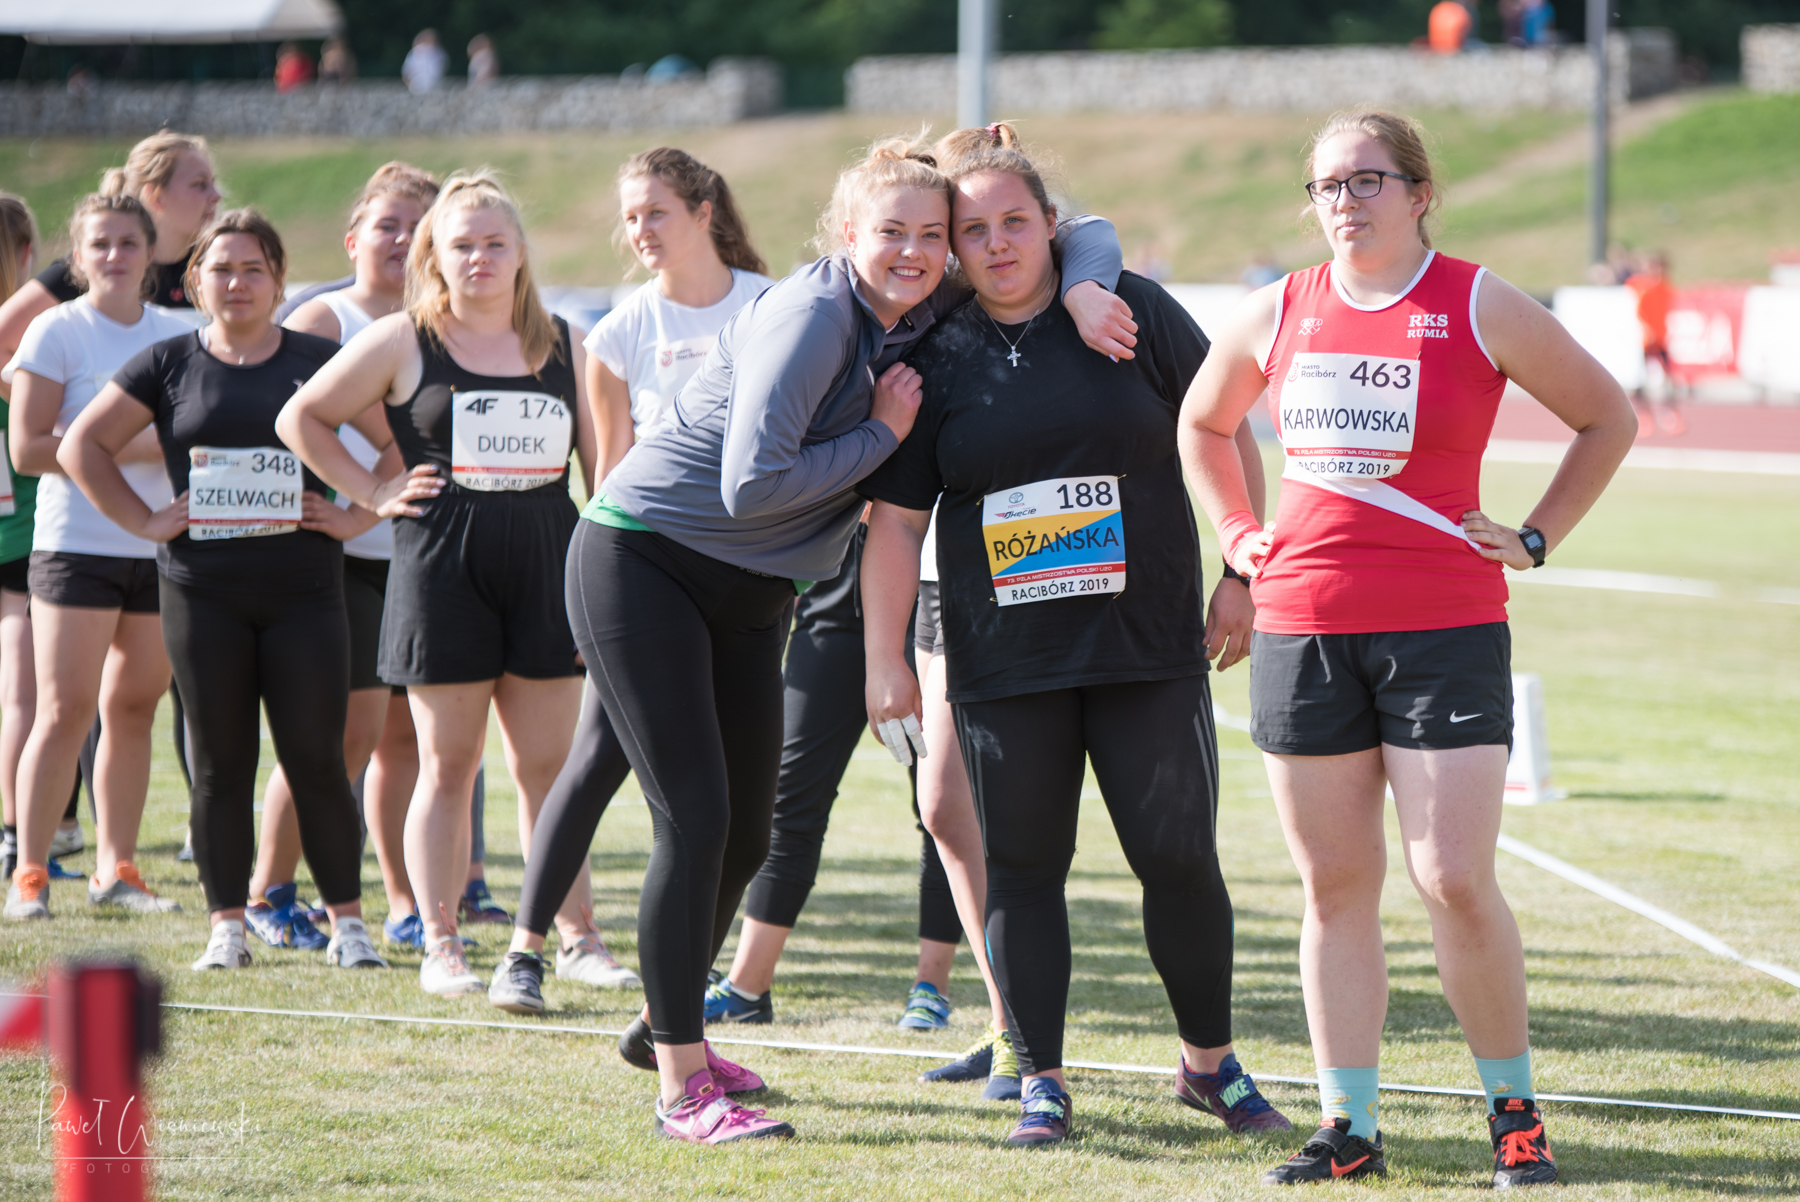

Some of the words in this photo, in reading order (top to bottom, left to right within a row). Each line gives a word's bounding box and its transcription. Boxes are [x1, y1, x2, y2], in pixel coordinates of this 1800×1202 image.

[1408, 313, 1448, 327] RKS
[1406, 329, 1449, 339] RUMIA
[1301, 369, 1337, 378] Racibórz
[1349, 360, 1411, 389] 463
[464, 397, 499, 415] 4F
[519, 397, 564, 420] 174
[1283, 408, 1410, 434] KARWOWSKA
[477, 435, 546, 455] DUDEK
[251, 452, 296, 476] 348
[1357, 462, 1390, 475] 2019
[466, 474, 523, 489] RACIBÓRZ
[195, 487, 295, 508] SZELWACH
[1056, 481, 1113, 509] 188
[993, 526, 1120, 561] RÓŻAŃSKA
[1032, 569, 1076, 580] MISTRZOSTWA
[1076, 566, 1098, 574] POLSKI
[1011, 580, 1075, 601] RACIBÓRZ
[1079, 578, 1109, 592] 2019
[1219, 1077, 1250, 1109] NIKE
[1507, 1098, 1524, 1106] NIKE
[700, 1097, 732, 1130] NIKE
